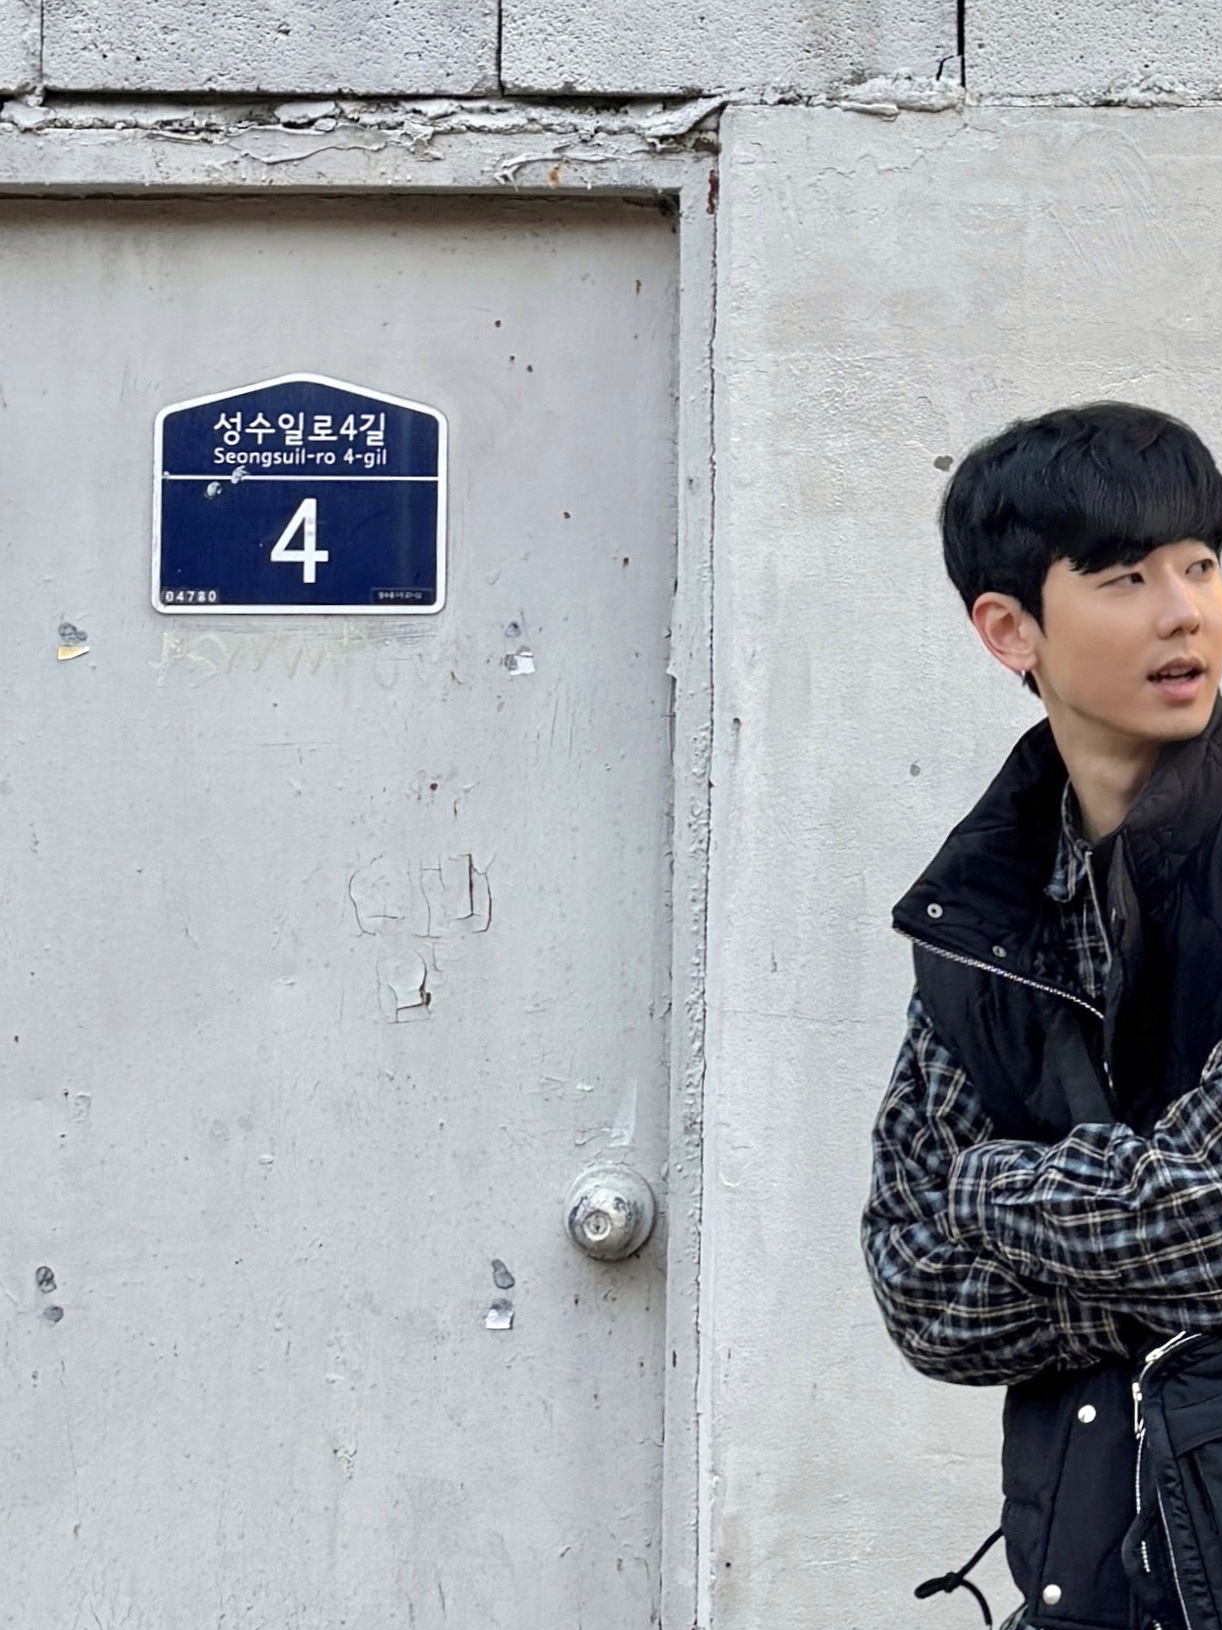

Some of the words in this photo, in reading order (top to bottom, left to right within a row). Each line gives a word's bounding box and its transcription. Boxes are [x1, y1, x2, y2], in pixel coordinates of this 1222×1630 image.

[213, 411, 386, 447] 성수일로4길
[213, 447, 336, 467] Seongsuil-ro
[343, 448, 387, 468] 4-gil
[270, 497, 329, 584] 4
[164, 590, 217, 603] 04780
